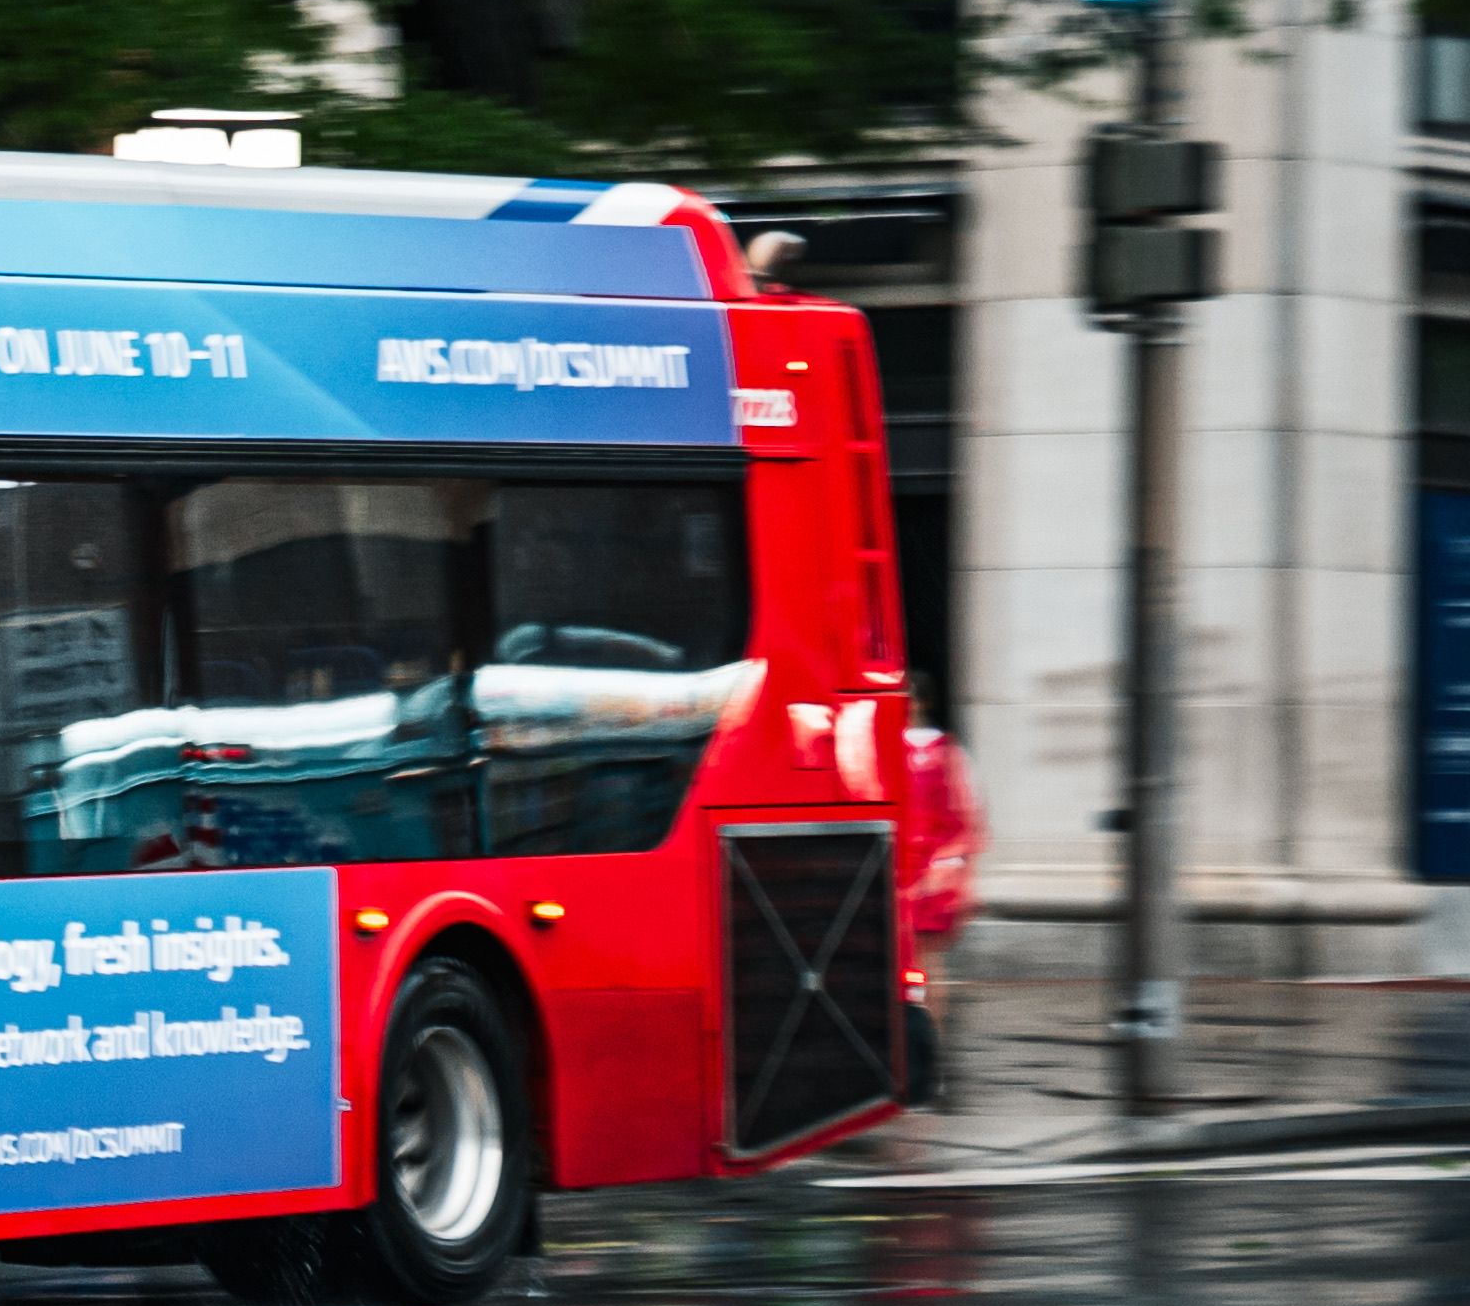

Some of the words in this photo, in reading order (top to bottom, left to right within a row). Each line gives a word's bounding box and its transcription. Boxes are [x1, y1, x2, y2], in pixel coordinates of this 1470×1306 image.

[54, 330, 144, 376] JUNE
[63, 921, 151, 975] fresh
[92, 1011, 150, 1061] and
[150, 1004, 311, 1063] knowledge.
